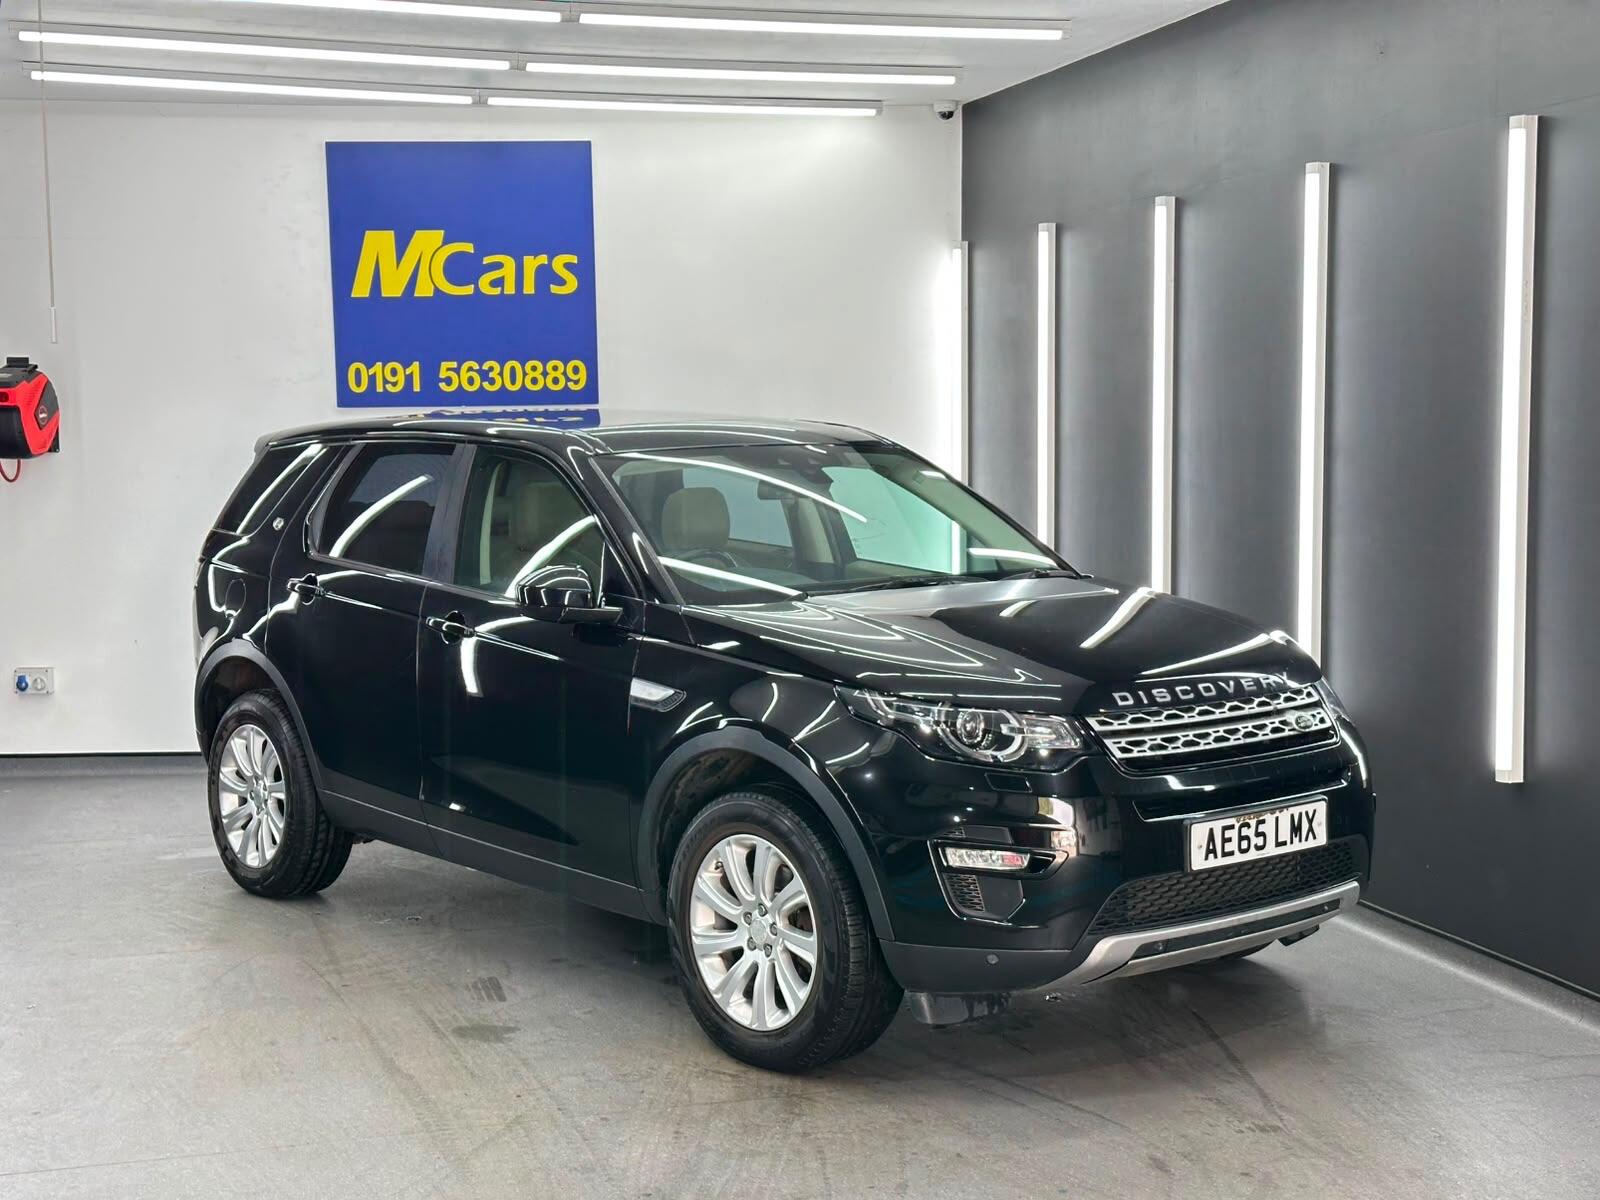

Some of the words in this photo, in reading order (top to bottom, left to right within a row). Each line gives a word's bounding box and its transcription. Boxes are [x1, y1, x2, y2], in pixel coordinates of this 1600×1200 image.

[347, 361, 421, 393] 0191
[438, 359, 588, 393] 5630889
[1204, 818, 1267, 861] AE65
[1274, 808, 1317, 848] LMX
